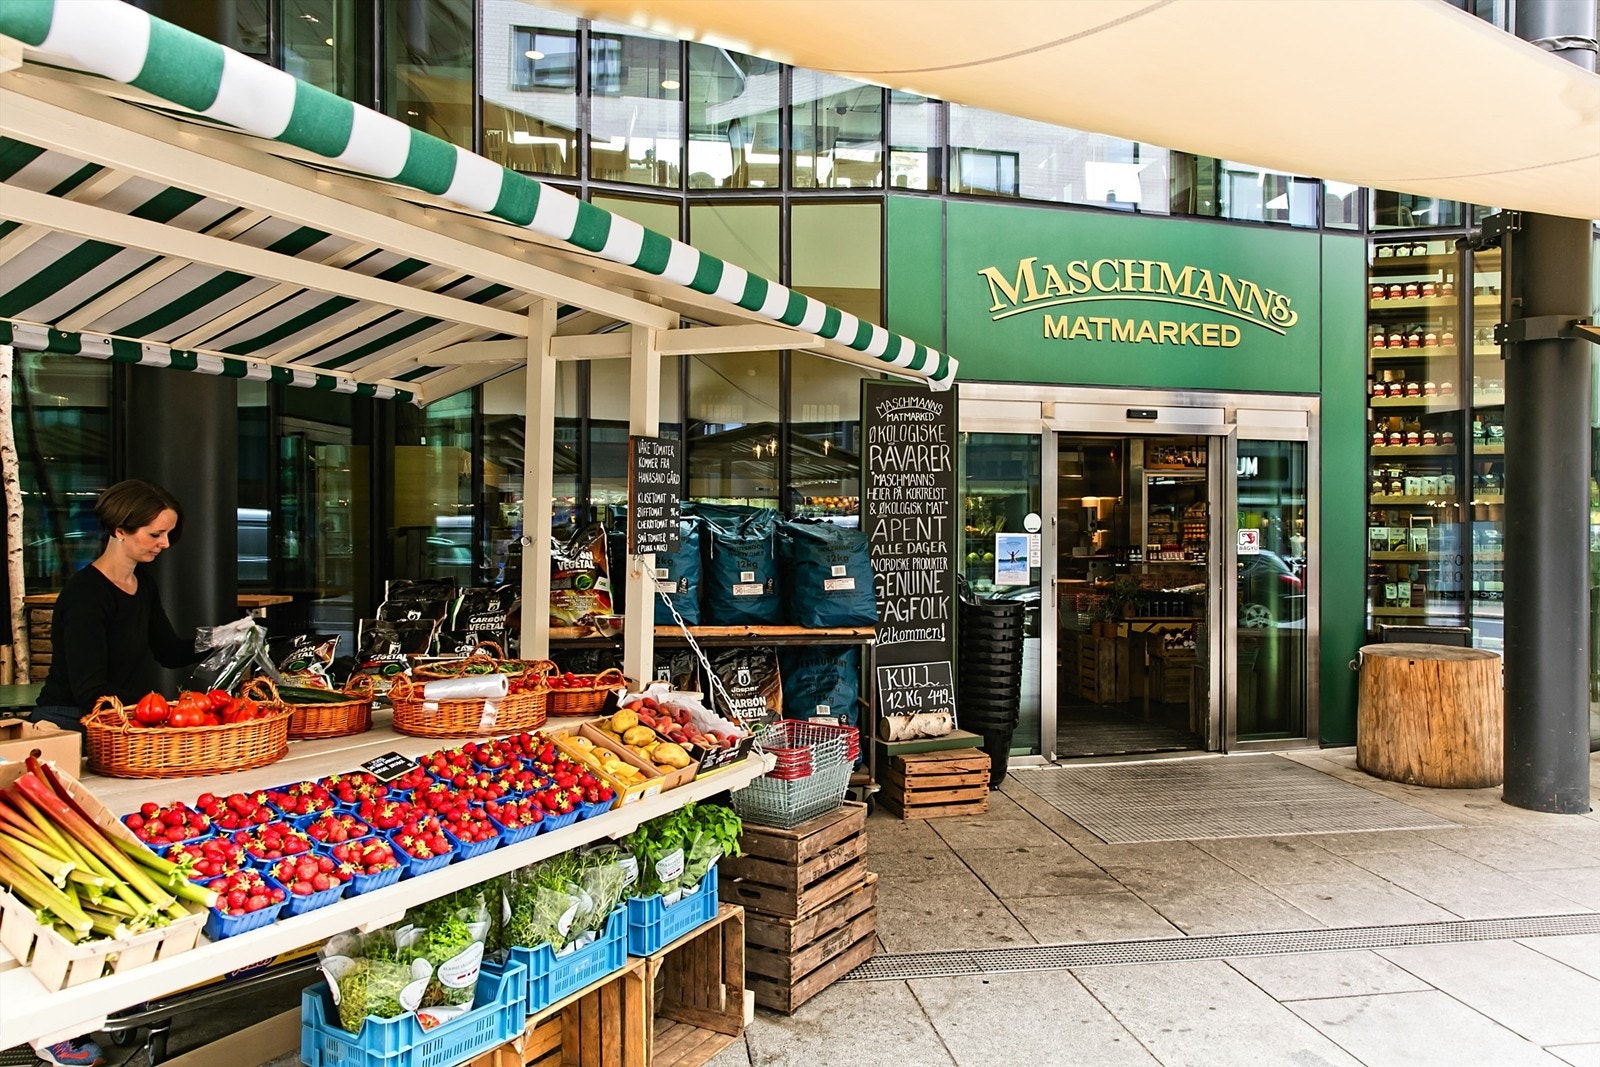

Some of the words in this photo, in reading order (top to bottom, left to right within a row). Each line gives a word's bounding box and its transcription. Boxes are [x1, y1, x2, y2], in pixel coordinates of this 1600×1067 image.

[978, 256, 1298, 326] MASCHMANNS
[1044, 314, 1241, 347] MATMARKED
[876, 396, 944, 418] MASCHMANNS
[886, 412, 934, 422] MATMARKED
[868, 424, 946, 444] ØKOLOGISKE
[654, 442, 675, 457] TOMATER
[870, 442, 952, 472] RÅVARER
[660, 458, 670, 469] FRA
[867, 488, 890, 500] HEIER
[893, 486, 903, 500] PÅ
[906, 488, 946, 500] KORTREIST
[870, 502, 876, 515] &
[878, 502, 922, 515] ØKOLOGISK
[870, 514, 947, 542] ÅPENT
[872, 543, 903, 556] ALLE
[907, 542, 948, 554] DAGER
[871, 558, 910, 572] NORDISKE
[912, 557, 948, 571] PRODUKTER
[874, 570, 944, 599] GENUINE
[876, 623, 946, 645] Velkommen!
[886, 667, 940, 690] KULL
[906, 689, 922, 708] KG
